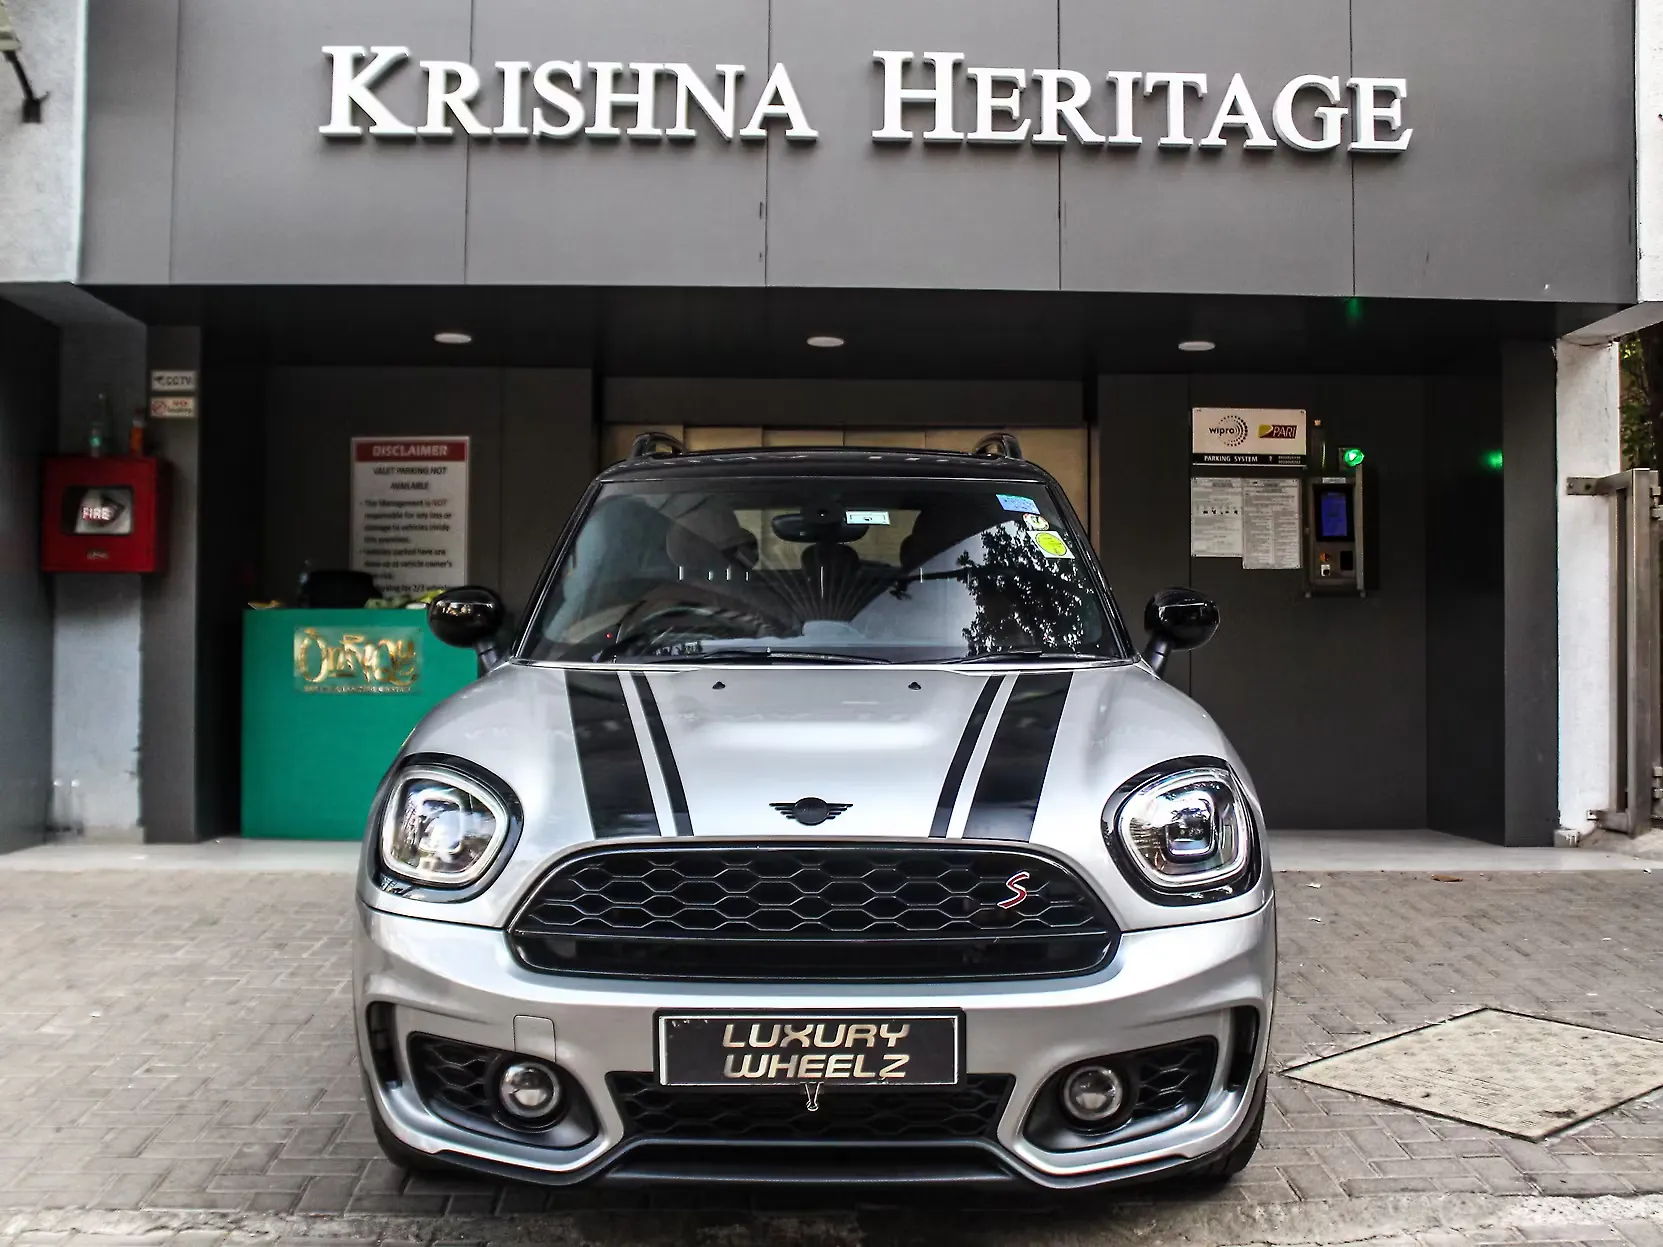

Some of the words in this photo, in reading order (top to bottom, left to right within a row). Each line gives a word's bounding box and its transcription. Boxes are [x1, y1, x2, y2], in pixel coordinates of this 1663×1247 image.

[318, 45, 819, 141] KRISHNA
[871, 49, 1414, 153] HERITAGE
[166, 375, 192, 386] CCTV
[1208, 426, 1235, 437] wipro
[1272, 426, 1297, 438] PARI
[372, 445, 448, 457] DISCLAIMER
[373, 467, 395, 475] VALET
[397, 467, 428, 475] PARKING
[431, 467, 447, 475] NOT
[390, 482, 429, 490] AVAILABLE
[82, 507, 110, 520] FIRE
[997, 871, 1030, 909] S
[722, 1023, 910, 1048] LUXURY
[723, 1054, 911, 1079] WHEELZ
